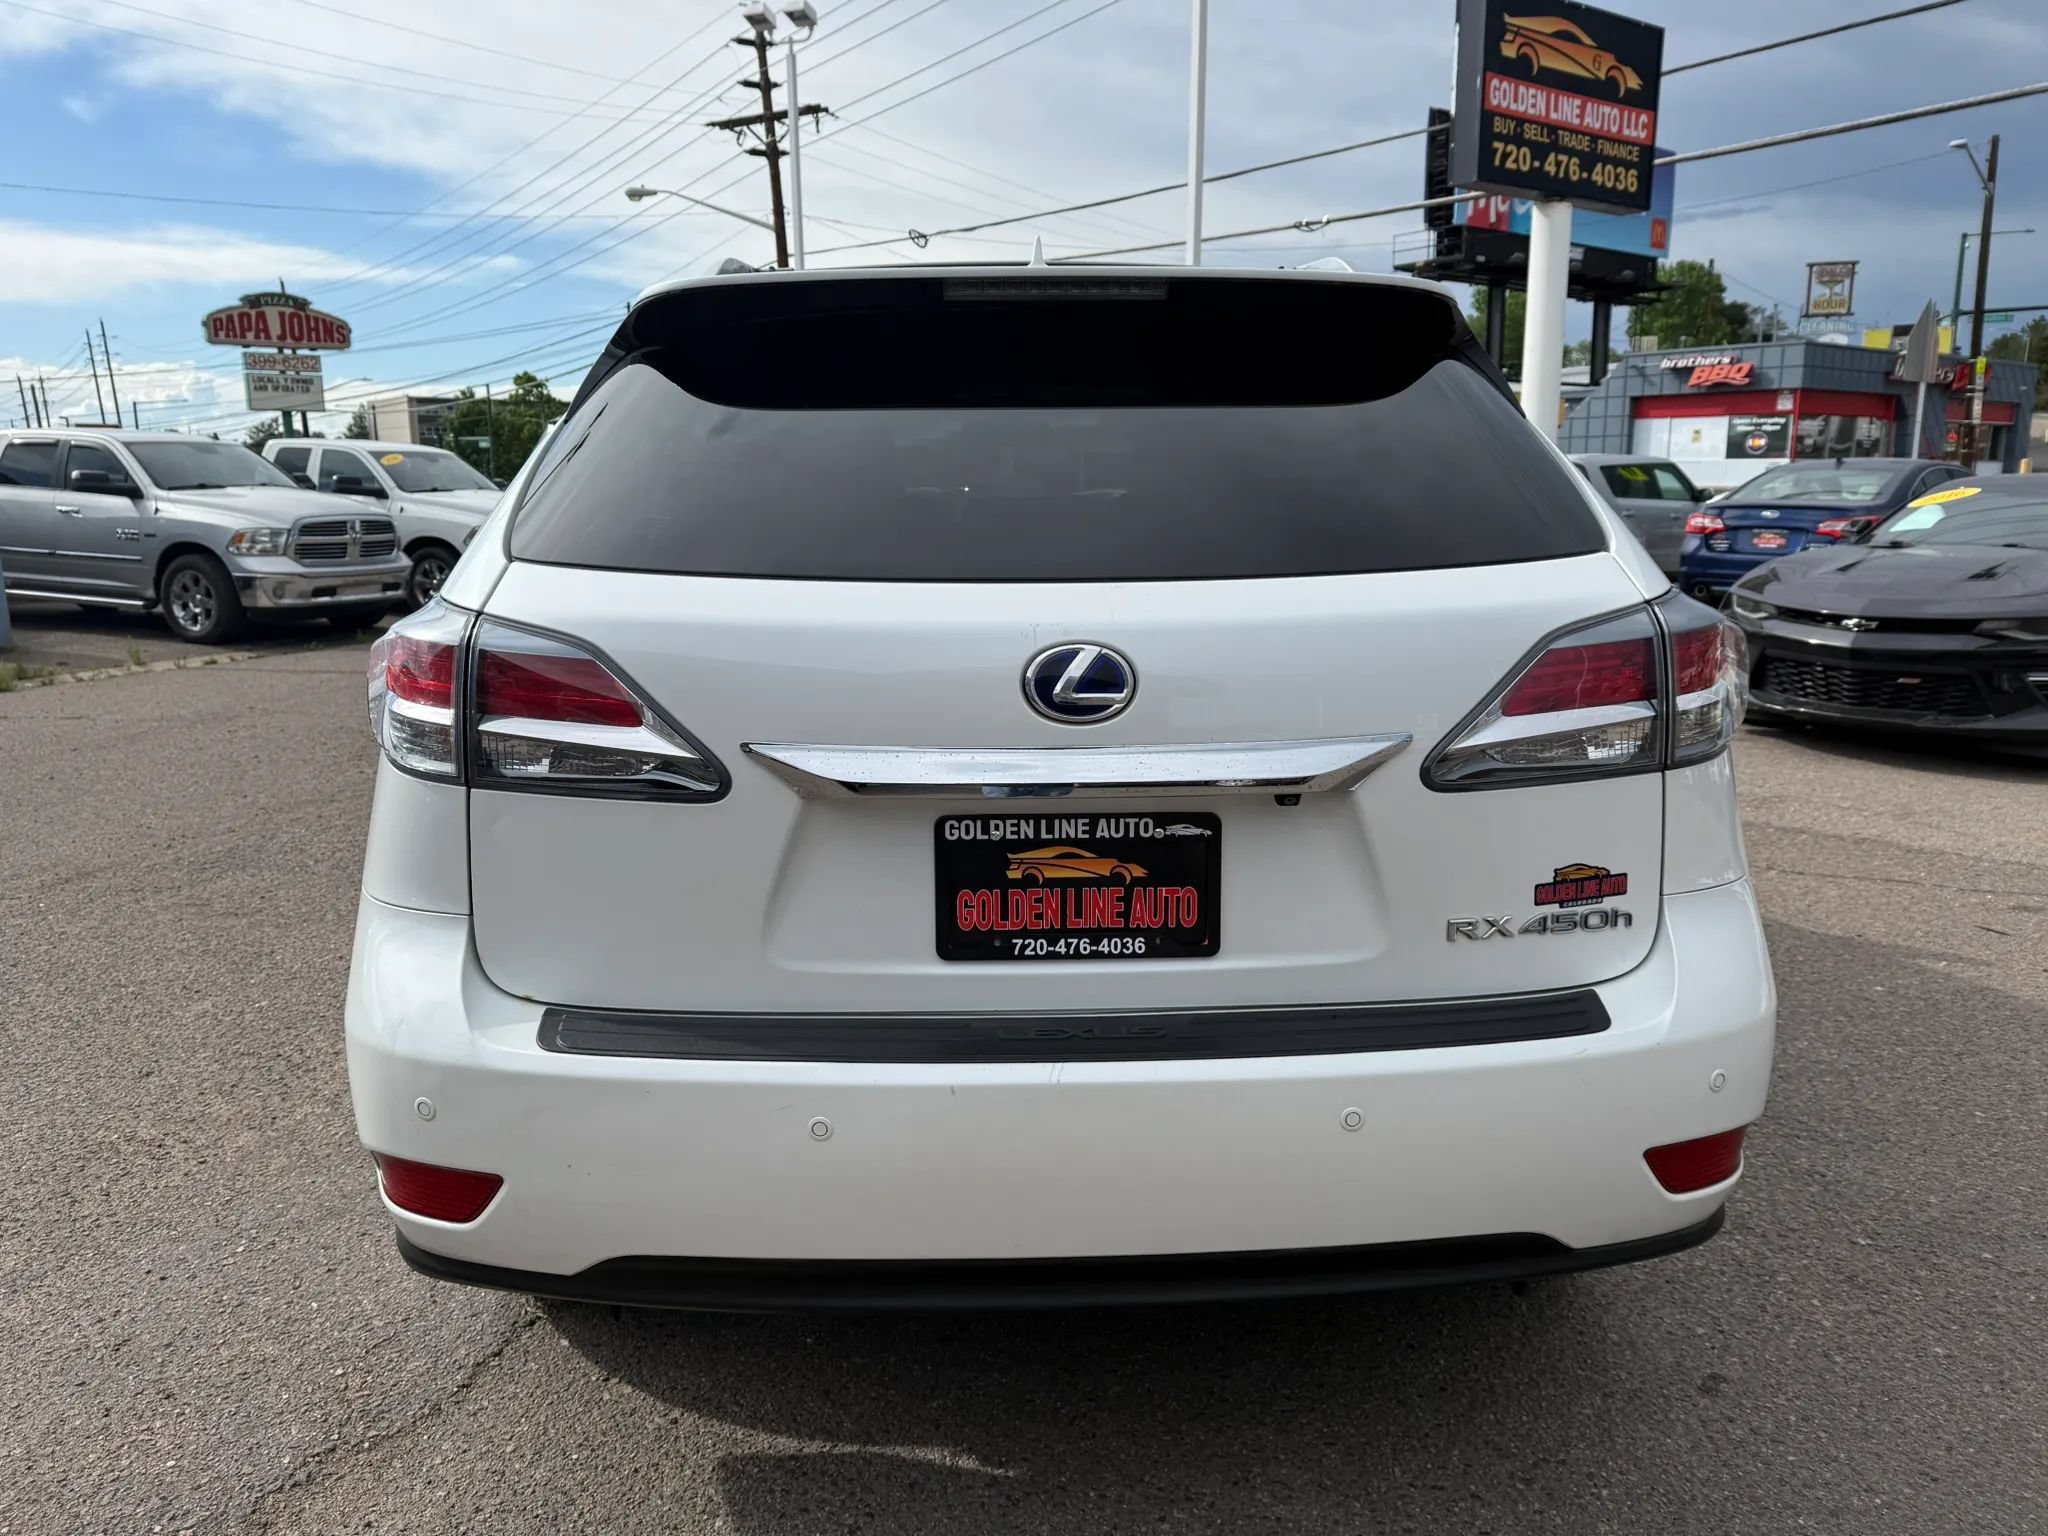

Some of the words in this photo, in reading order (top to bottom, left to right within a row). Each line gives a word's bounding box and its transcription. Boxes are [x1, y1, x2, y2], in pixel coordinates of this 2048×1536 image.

[1489, 78, 1547, 117] GOLDEN
[1550, 92, 1580, 125] LINE
[1583, 101, 1620, 133] AUTO
[1623, 110, 1648, 138] LLC
[1493, 116, 1517, 136] BUY
[1523, 122, 1550, 143] SELL
[1558, 130, 1591, 151] TRADE
[1597, 138, 1640, 162] FINANCE
[259, 295, 294, 306] PIZZA
[1812, 298, 1846, 310] HOUR
[212, 310, 272, 340] PAPA
[276, 310, 346, 344] JOHNS
[248, 355, 319, 370] 399-6262
[1661, 354, 1732, 370] brothers
[1688, 362, 1756, 388] BBQ
[944, 820, 1034, 841] GOLDEN
[1040, 819, 1090, 839] LINE
[1536, 883, 1577, 904] GOLDEN
[1577, 879, 1600, 898] LINE
[1601, 876, 1627, 896] AUTO
[957, 888, 1060, 931] GOLDEN
[1066, 887, 1125, 929] LINE
[1129, 886, 1198, 928] AUTO
[1446, 914, 1515, 942] RX
[1518, 907, 1633, 936] 450h
[1011, 937, 1146, 955] 720-476-4036
[997, 1026, 1169, 1041] LEXUS
